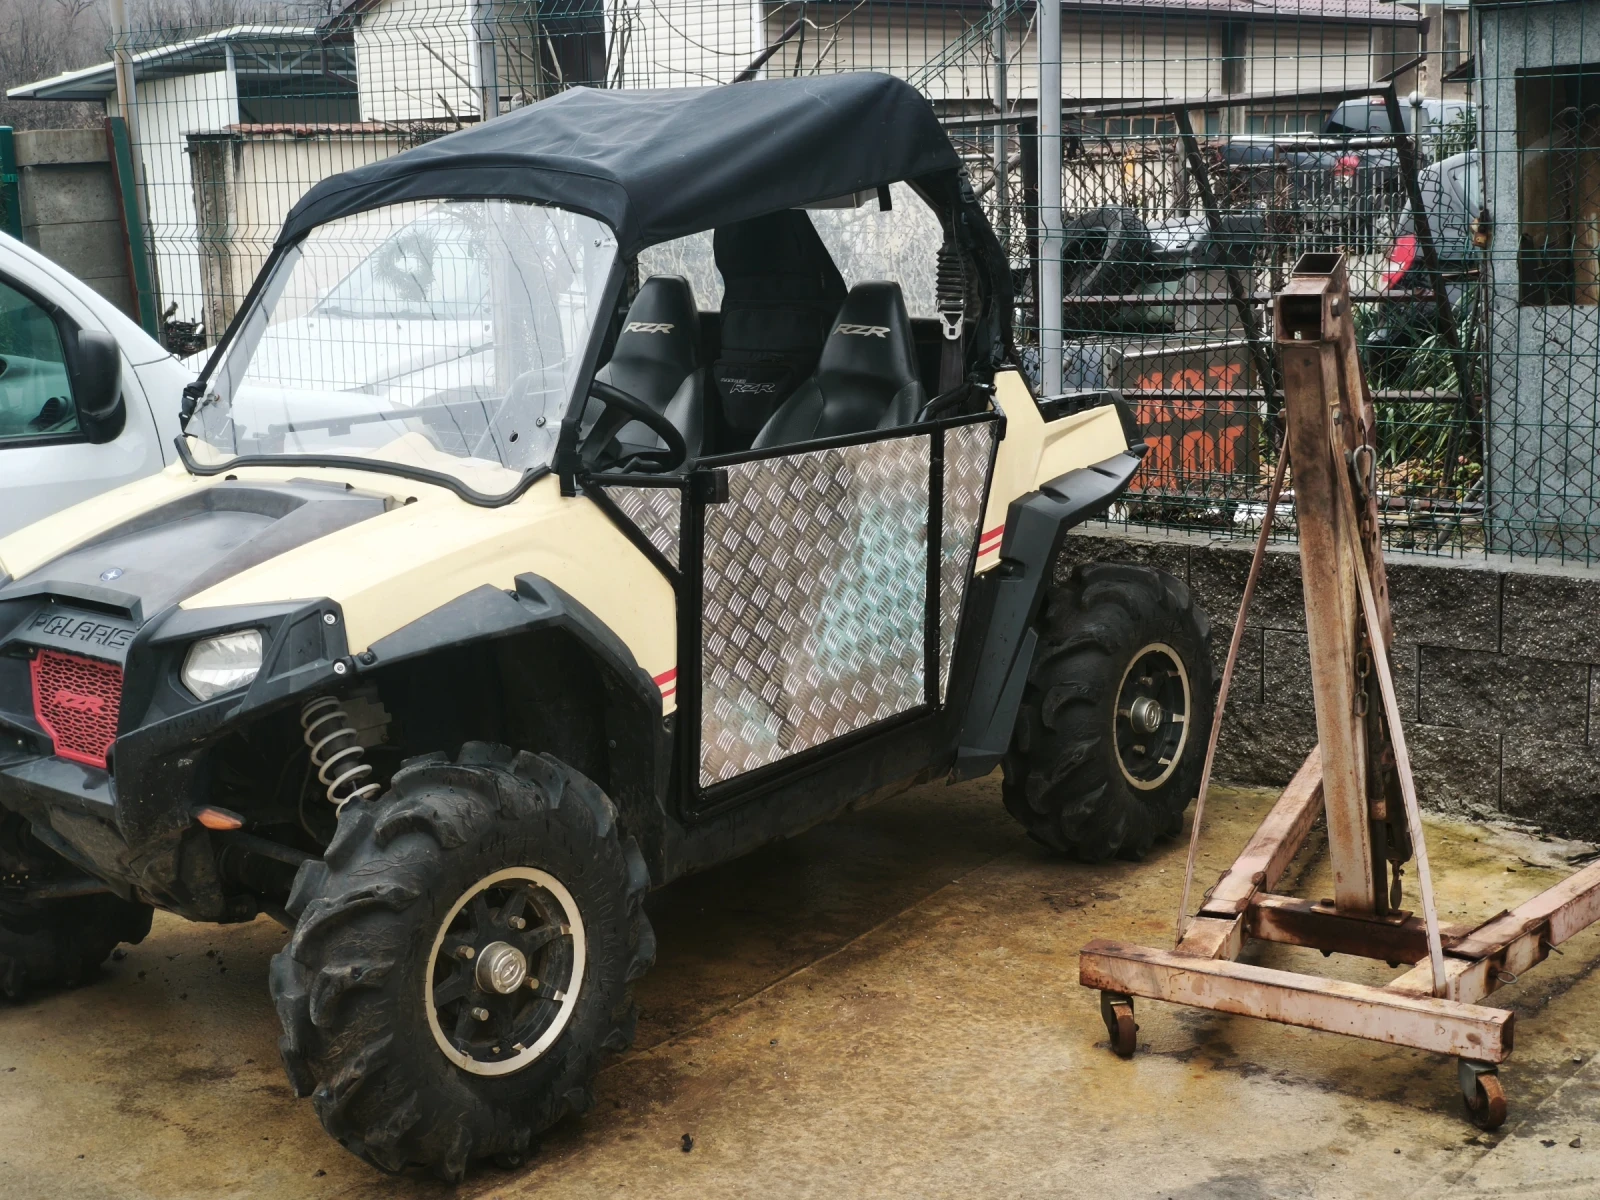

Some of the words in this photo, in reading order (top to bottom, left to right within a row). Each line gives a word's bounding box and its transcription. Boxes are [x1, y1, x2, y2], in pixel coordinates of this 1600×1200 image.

[623, 321, 675, 334] RZR
[832, 323, 891, 338] RZR
[729, 382, 777, 395] RZR
[27, 612, 136, 650] POLARIS
[53, 689, 106, 715] RZR
